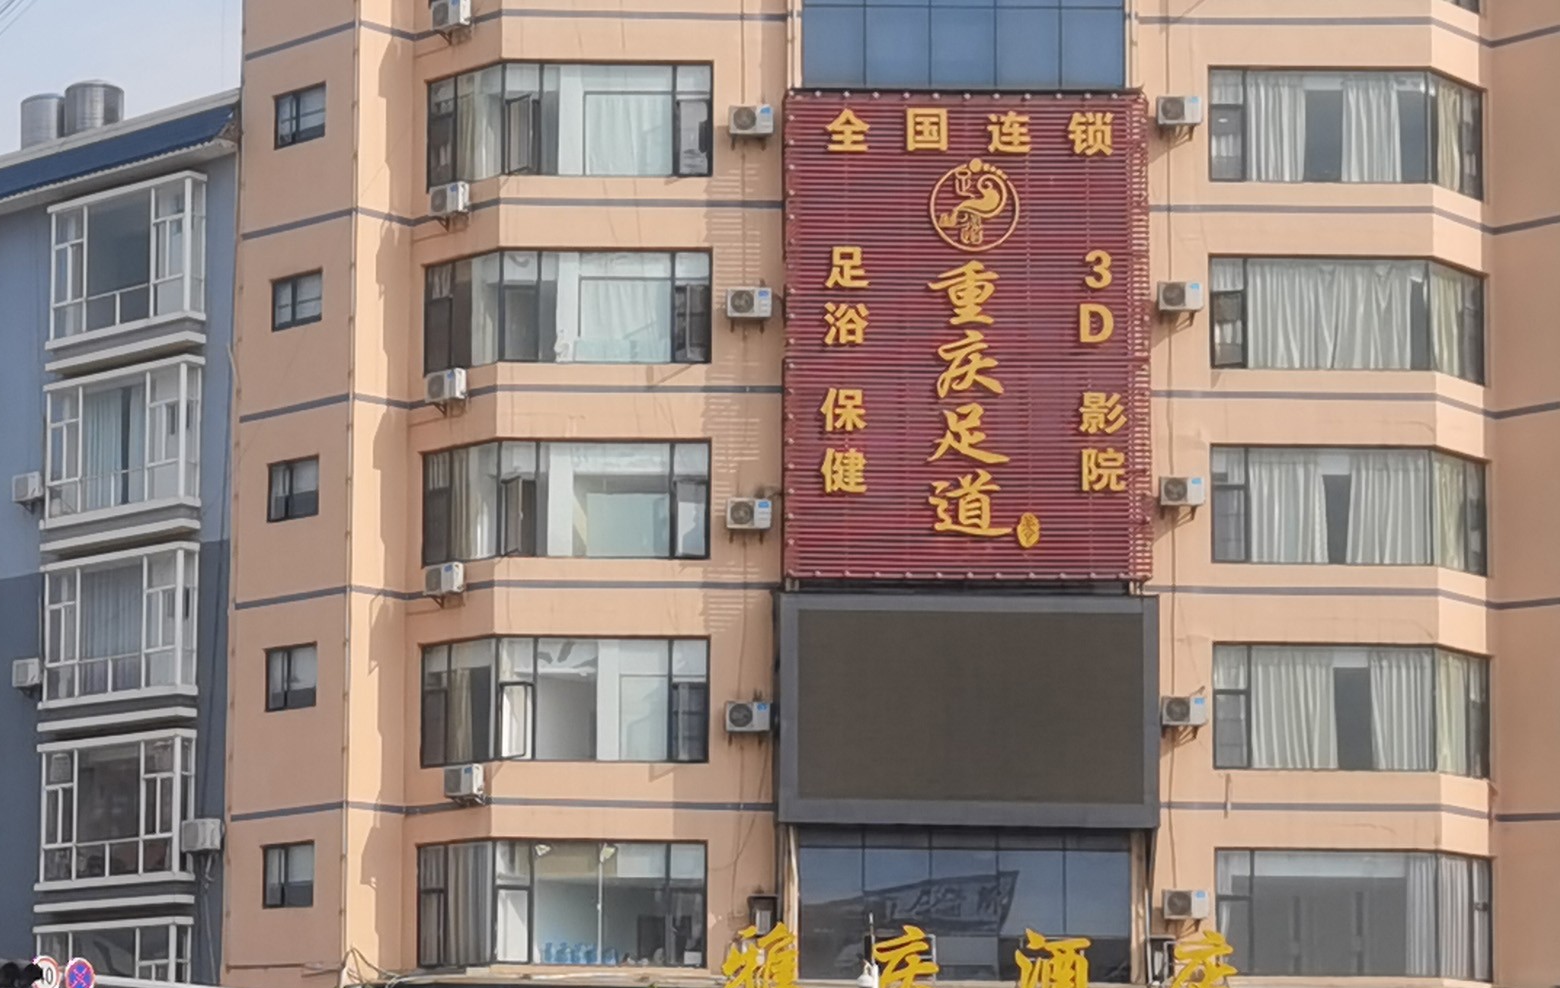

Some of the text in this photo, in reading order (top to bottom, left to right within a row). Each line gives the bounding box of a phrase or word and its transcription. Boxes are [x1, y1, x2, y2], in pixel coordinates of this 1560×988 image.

[826, 107, 1115, 156] 全国连锁
[927, 259, 1013, 538] 重庆足道
